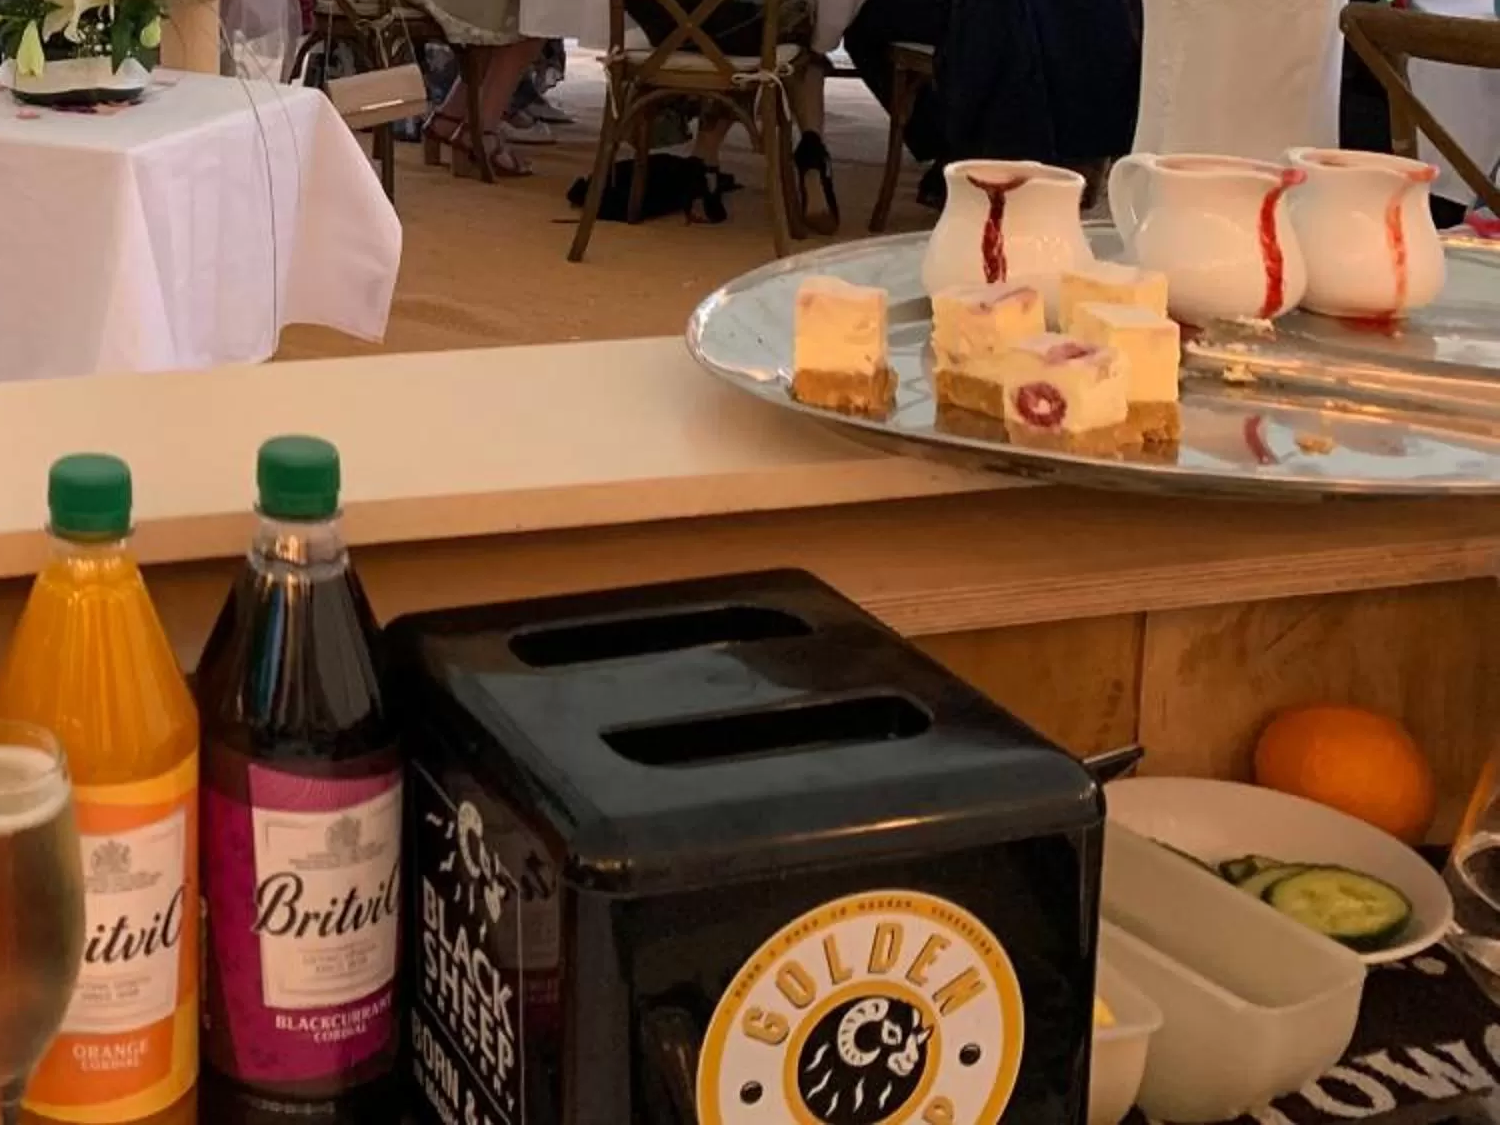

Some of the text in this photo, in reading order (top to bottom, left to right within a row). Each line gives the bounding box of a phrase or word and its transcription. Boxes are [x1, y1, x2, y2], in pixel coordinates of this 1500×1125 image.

[275, 991, 392, 1032] BLACKCURRANT
[423, 874, 515, 1043] BLACK
[423, 929, 515, 1083] SHEEP
[742, 921, 987, 1046] GOLDEN
[71, 1038, 149, 1061] ORANGE
